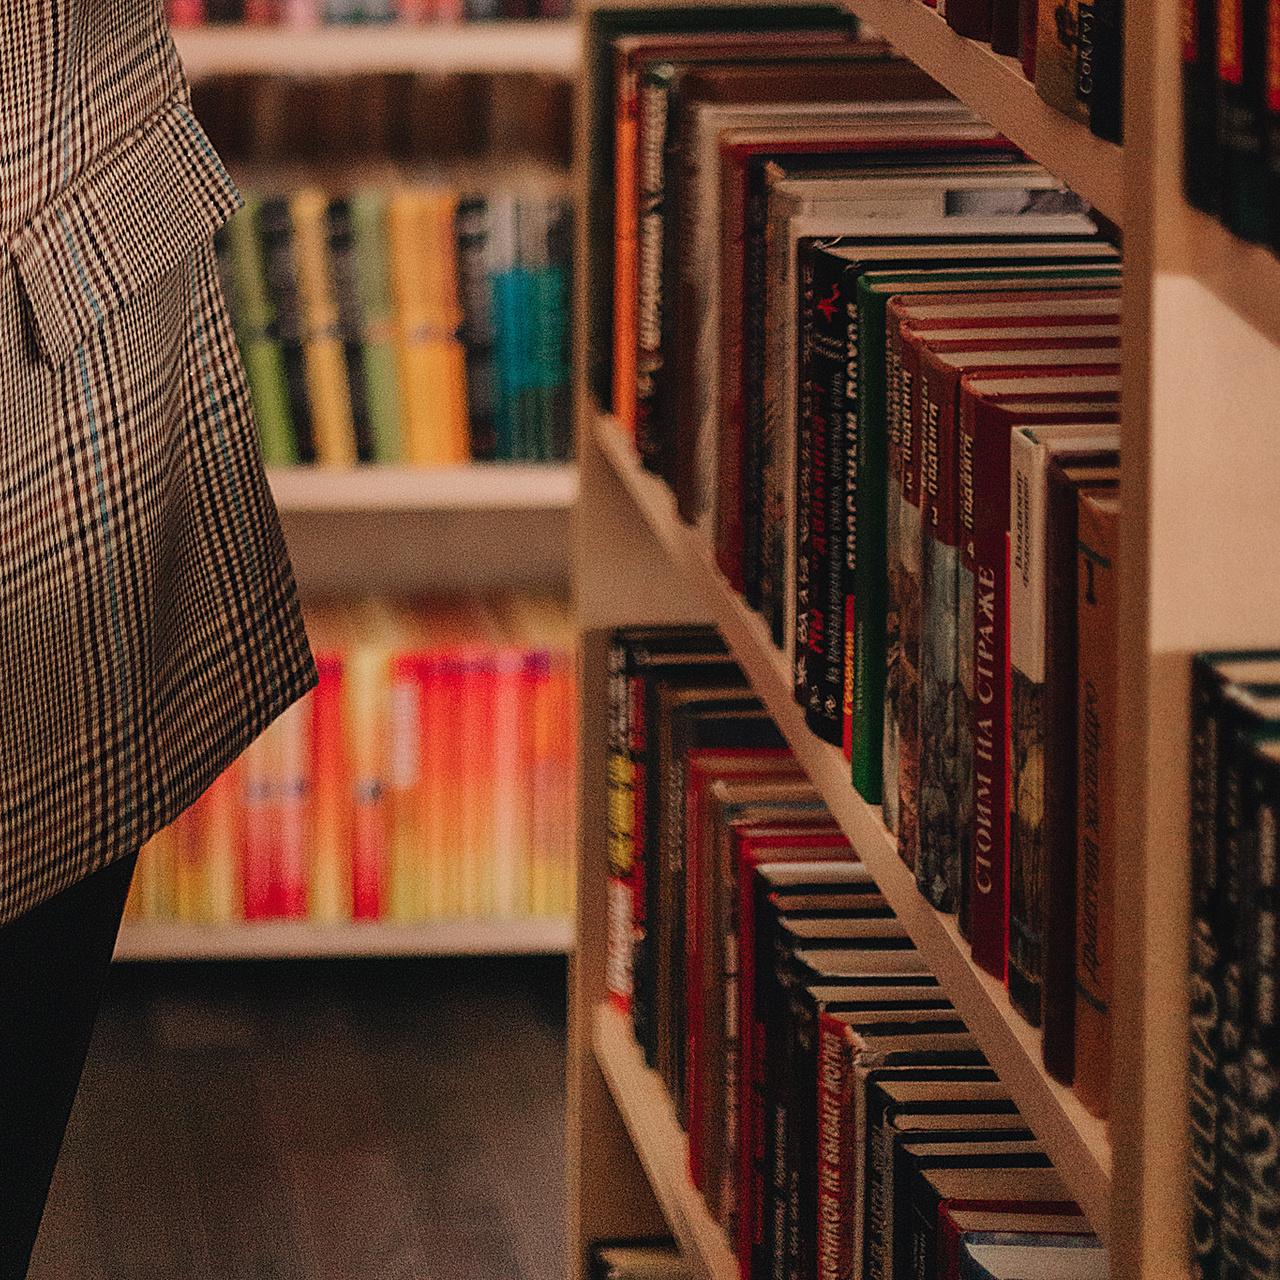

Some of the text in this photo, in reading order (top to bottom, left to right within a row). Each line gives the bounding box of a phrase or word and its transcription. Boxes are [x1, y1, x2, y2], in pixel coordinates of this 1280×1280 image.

[926, 402, 939, 496] ПОДВИГА
[962, 432, 975, 530] ПОДВИГА
[975, 565, 996, 895] СТОИМ НА СТРАЖЕ
